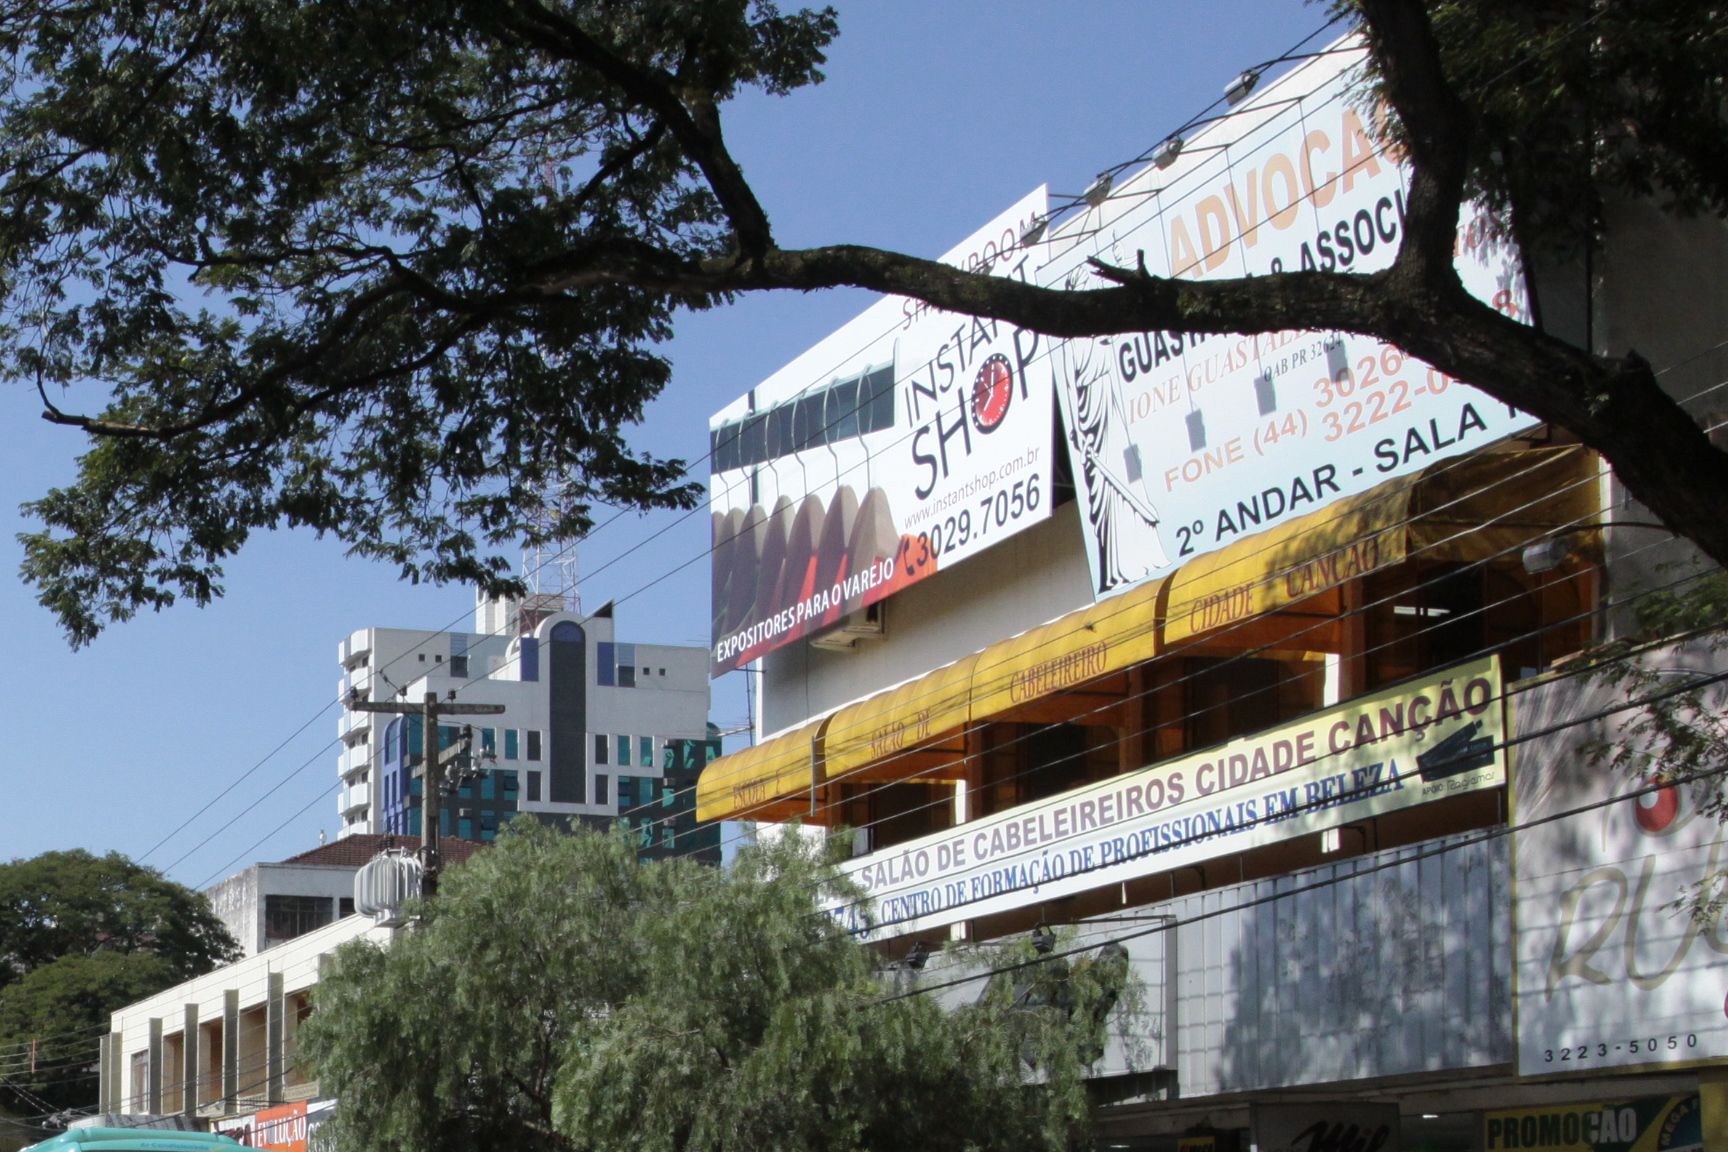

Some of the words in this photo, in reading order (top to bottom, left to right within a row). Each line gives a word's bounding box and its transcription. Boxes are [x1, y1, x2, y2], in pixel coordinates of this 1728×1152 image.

[1129, 373, 1181, 426] IONE
[1263, 357, 1289, 383] OAB
[1291, 347, 1308, 370] PR
[904, 446, 1041, 530] www.instantshop.com.br
[1164, 438, 1244, 493] FONE
[1254, 409, 1307, 457] (44)
[1214, 462, 1342, 543] ANDAR
[1374, 402, 1489, 474] SALA
[916, 472, 1040, 567] 3029.7056
[716, 606, 795, 663] EXPOSITORES
[797, 589, 830, 624] PARA
[831, 583, 841, 606] O
[843, 556, 895, 601] VAREJO
[1189, 581, 1256, 634] CIDADE
[1009, 641, 1109, 703] CABELEIREIRO
[861, 847, 930, 891] SALÃO
[937, 838, 967, 872] DE
[972, 771, 1185, 862] CABELEIREIROS
[1195, 731, 1317, 797] CIDADE
[1328, 677, 1492, 755] CANÇÃO
[881, 886, 942, 925] CENTRO
[945, 881, 967, 907] DE
[972, 849, 1066, 896] FORMAÇÃO
[1070, 845, 1095, 874] DE
[1100, 798, 1258, 865] PROFISSIONAIS
[1263, 787, 1299, 826] EM
[1304, 758, 1405, 816] BELEZA
